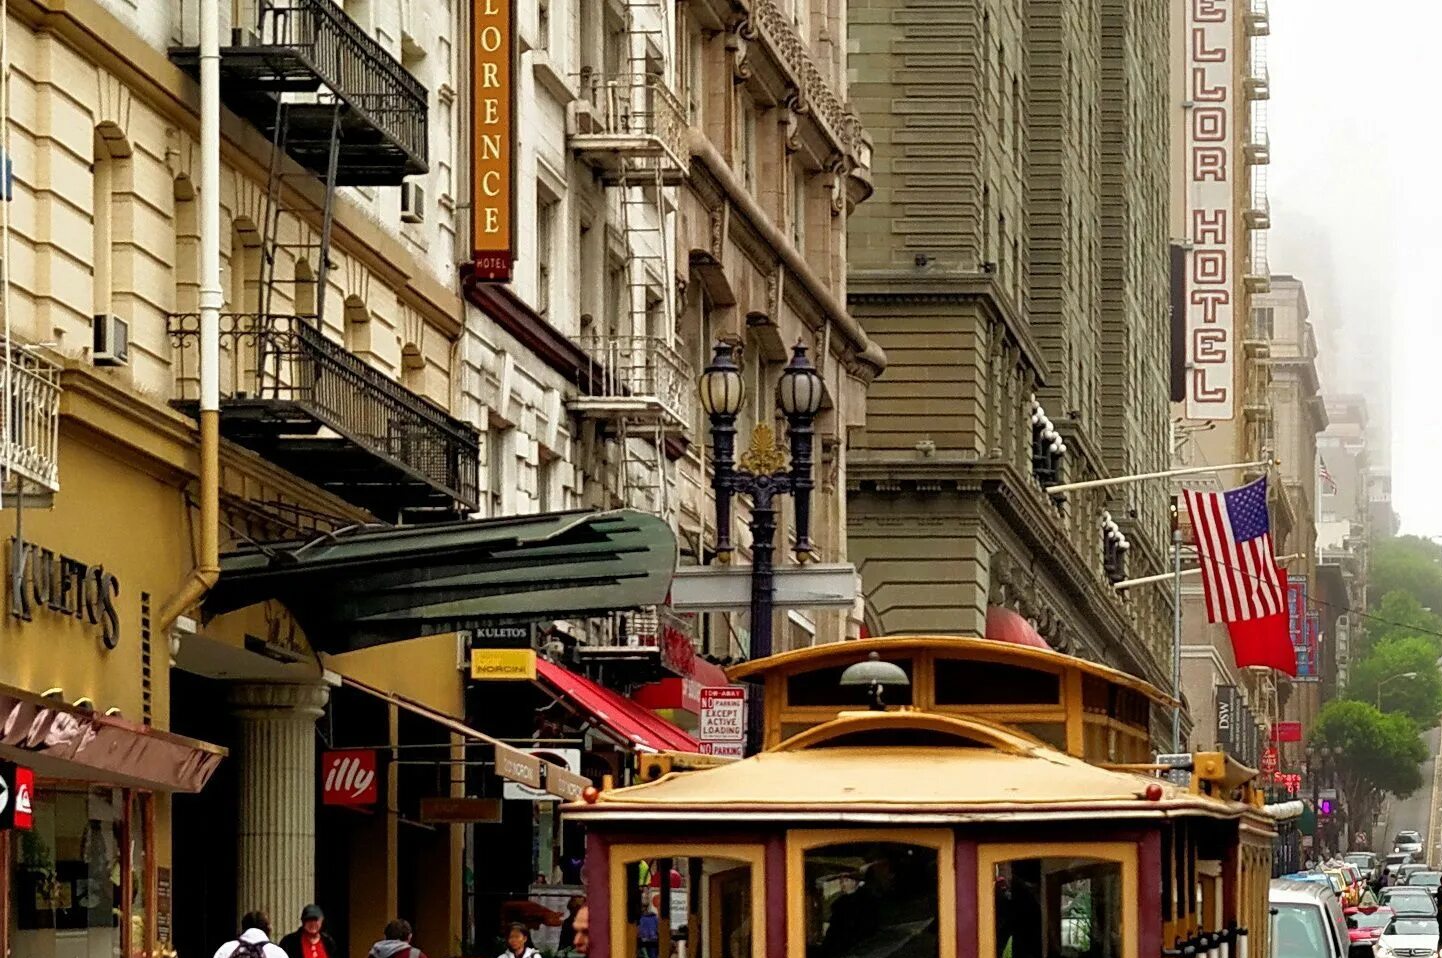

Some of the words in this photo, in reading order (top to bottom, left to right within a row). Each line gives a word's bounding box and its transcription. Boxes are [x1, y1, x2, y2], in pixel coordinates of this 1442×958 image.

[476, 258, 507, 269] HOTEL
[1190, 209, 1230, 404] HOTEL
[701, 697, 713, 709] NO
[1218, 701, 1230, 729] DSW
[706, 718, 737, 726] ACTIVE
[703, 726, 740, 735] LOADING
[699, 743, 712, 754] NO
[713, 746, 741, 755] PARKING
[325, 756, 375, 798] illy
